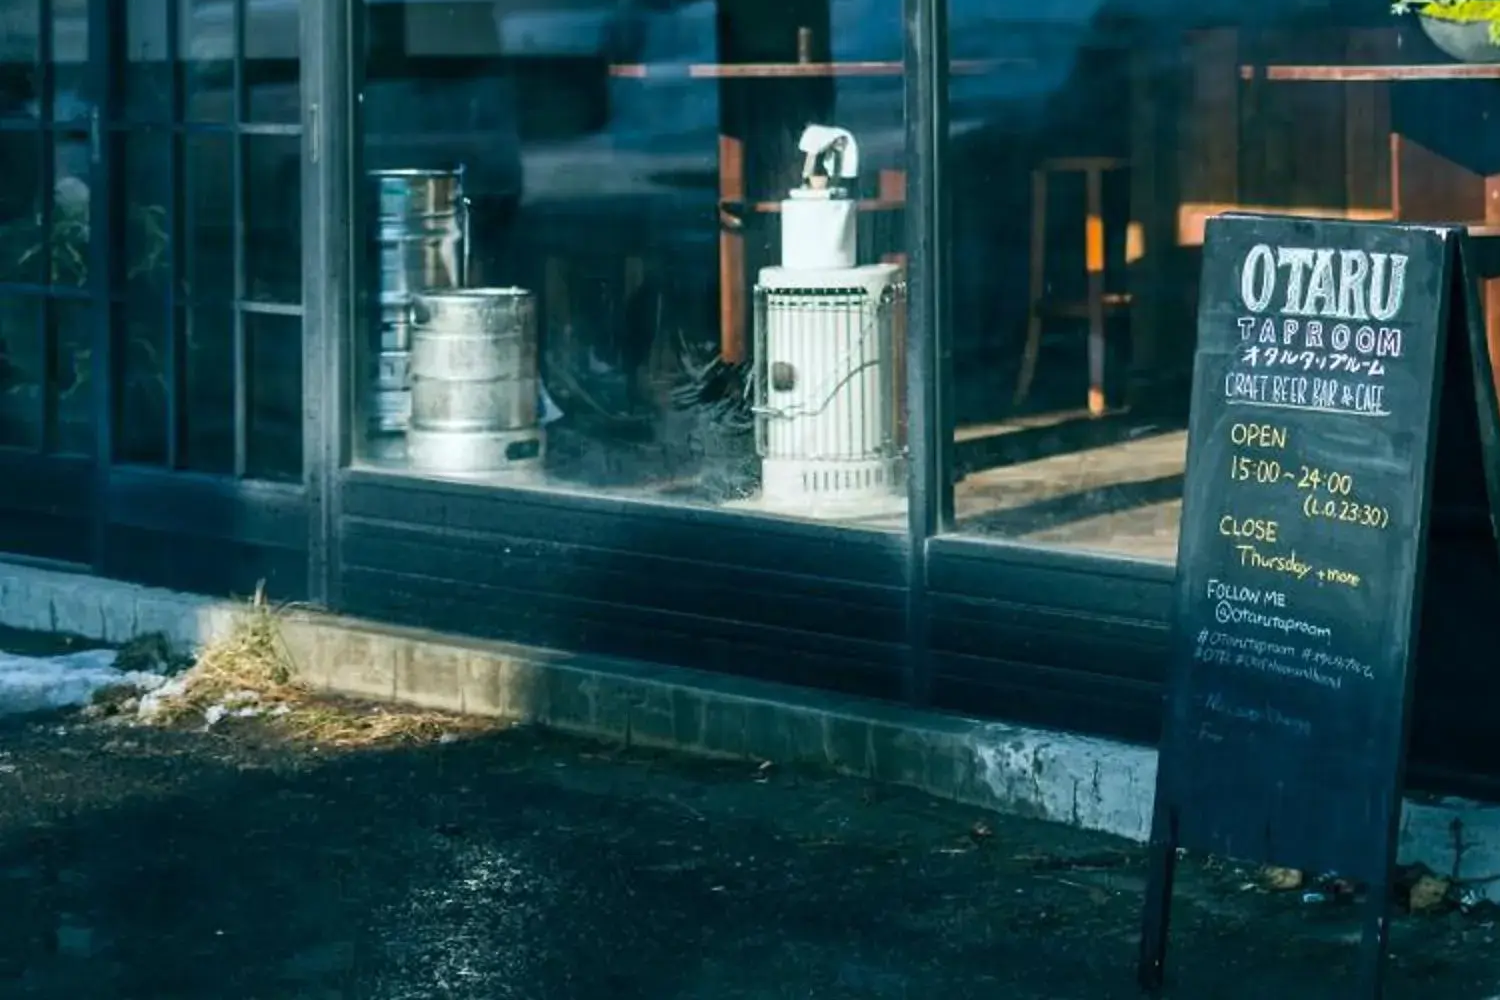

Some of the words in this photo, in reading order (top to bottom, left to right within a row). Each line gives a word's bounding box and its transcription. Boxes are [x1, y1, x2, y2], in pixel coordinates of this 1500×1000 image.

[1240, 243, 1409, 321] OTARU
[1237, 316, 1402, 358] TAPROOM
[1225, 371, 1269, 402] CRAFT
[1273, 375, 1308, 405] BEER
[1313, 377, 1339, 407] BAR
[1355, 383, 1385, 413] CAFE
[1231, 423, 1287, 448] OPEN
[1219, 514, 1280, 543] CLOSE
[1235, 544, 1313, 580] Thursday
[1262, 591, 1287, 608] ME
